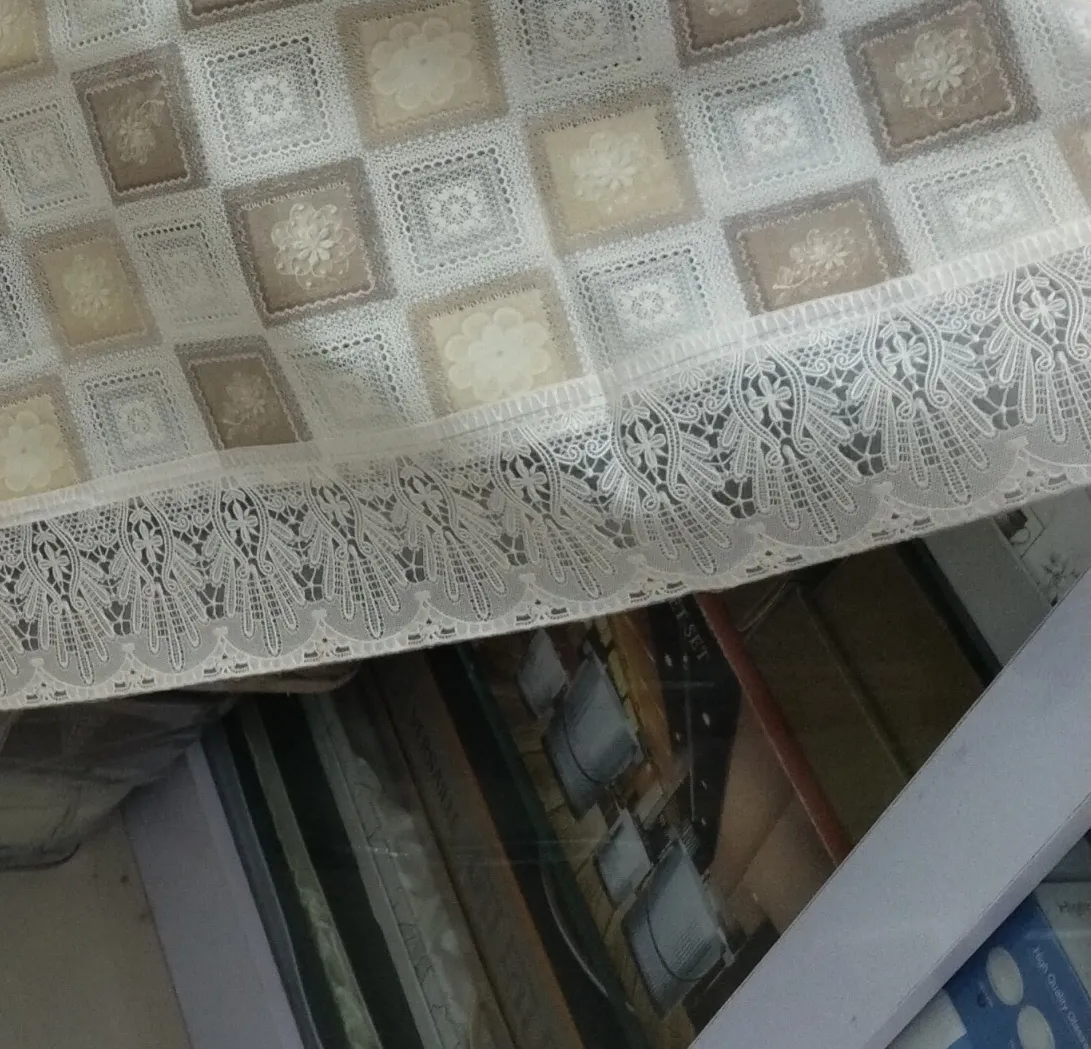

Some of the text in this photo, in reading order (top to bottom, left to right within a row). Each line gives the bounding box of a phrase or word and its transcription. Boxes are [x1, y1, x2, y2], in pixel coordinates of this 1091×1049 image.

[684, 624, 708, 660] SET
[1033, 945, 1049, 973] High
[1047, 973, 1068, 1011] Quality
